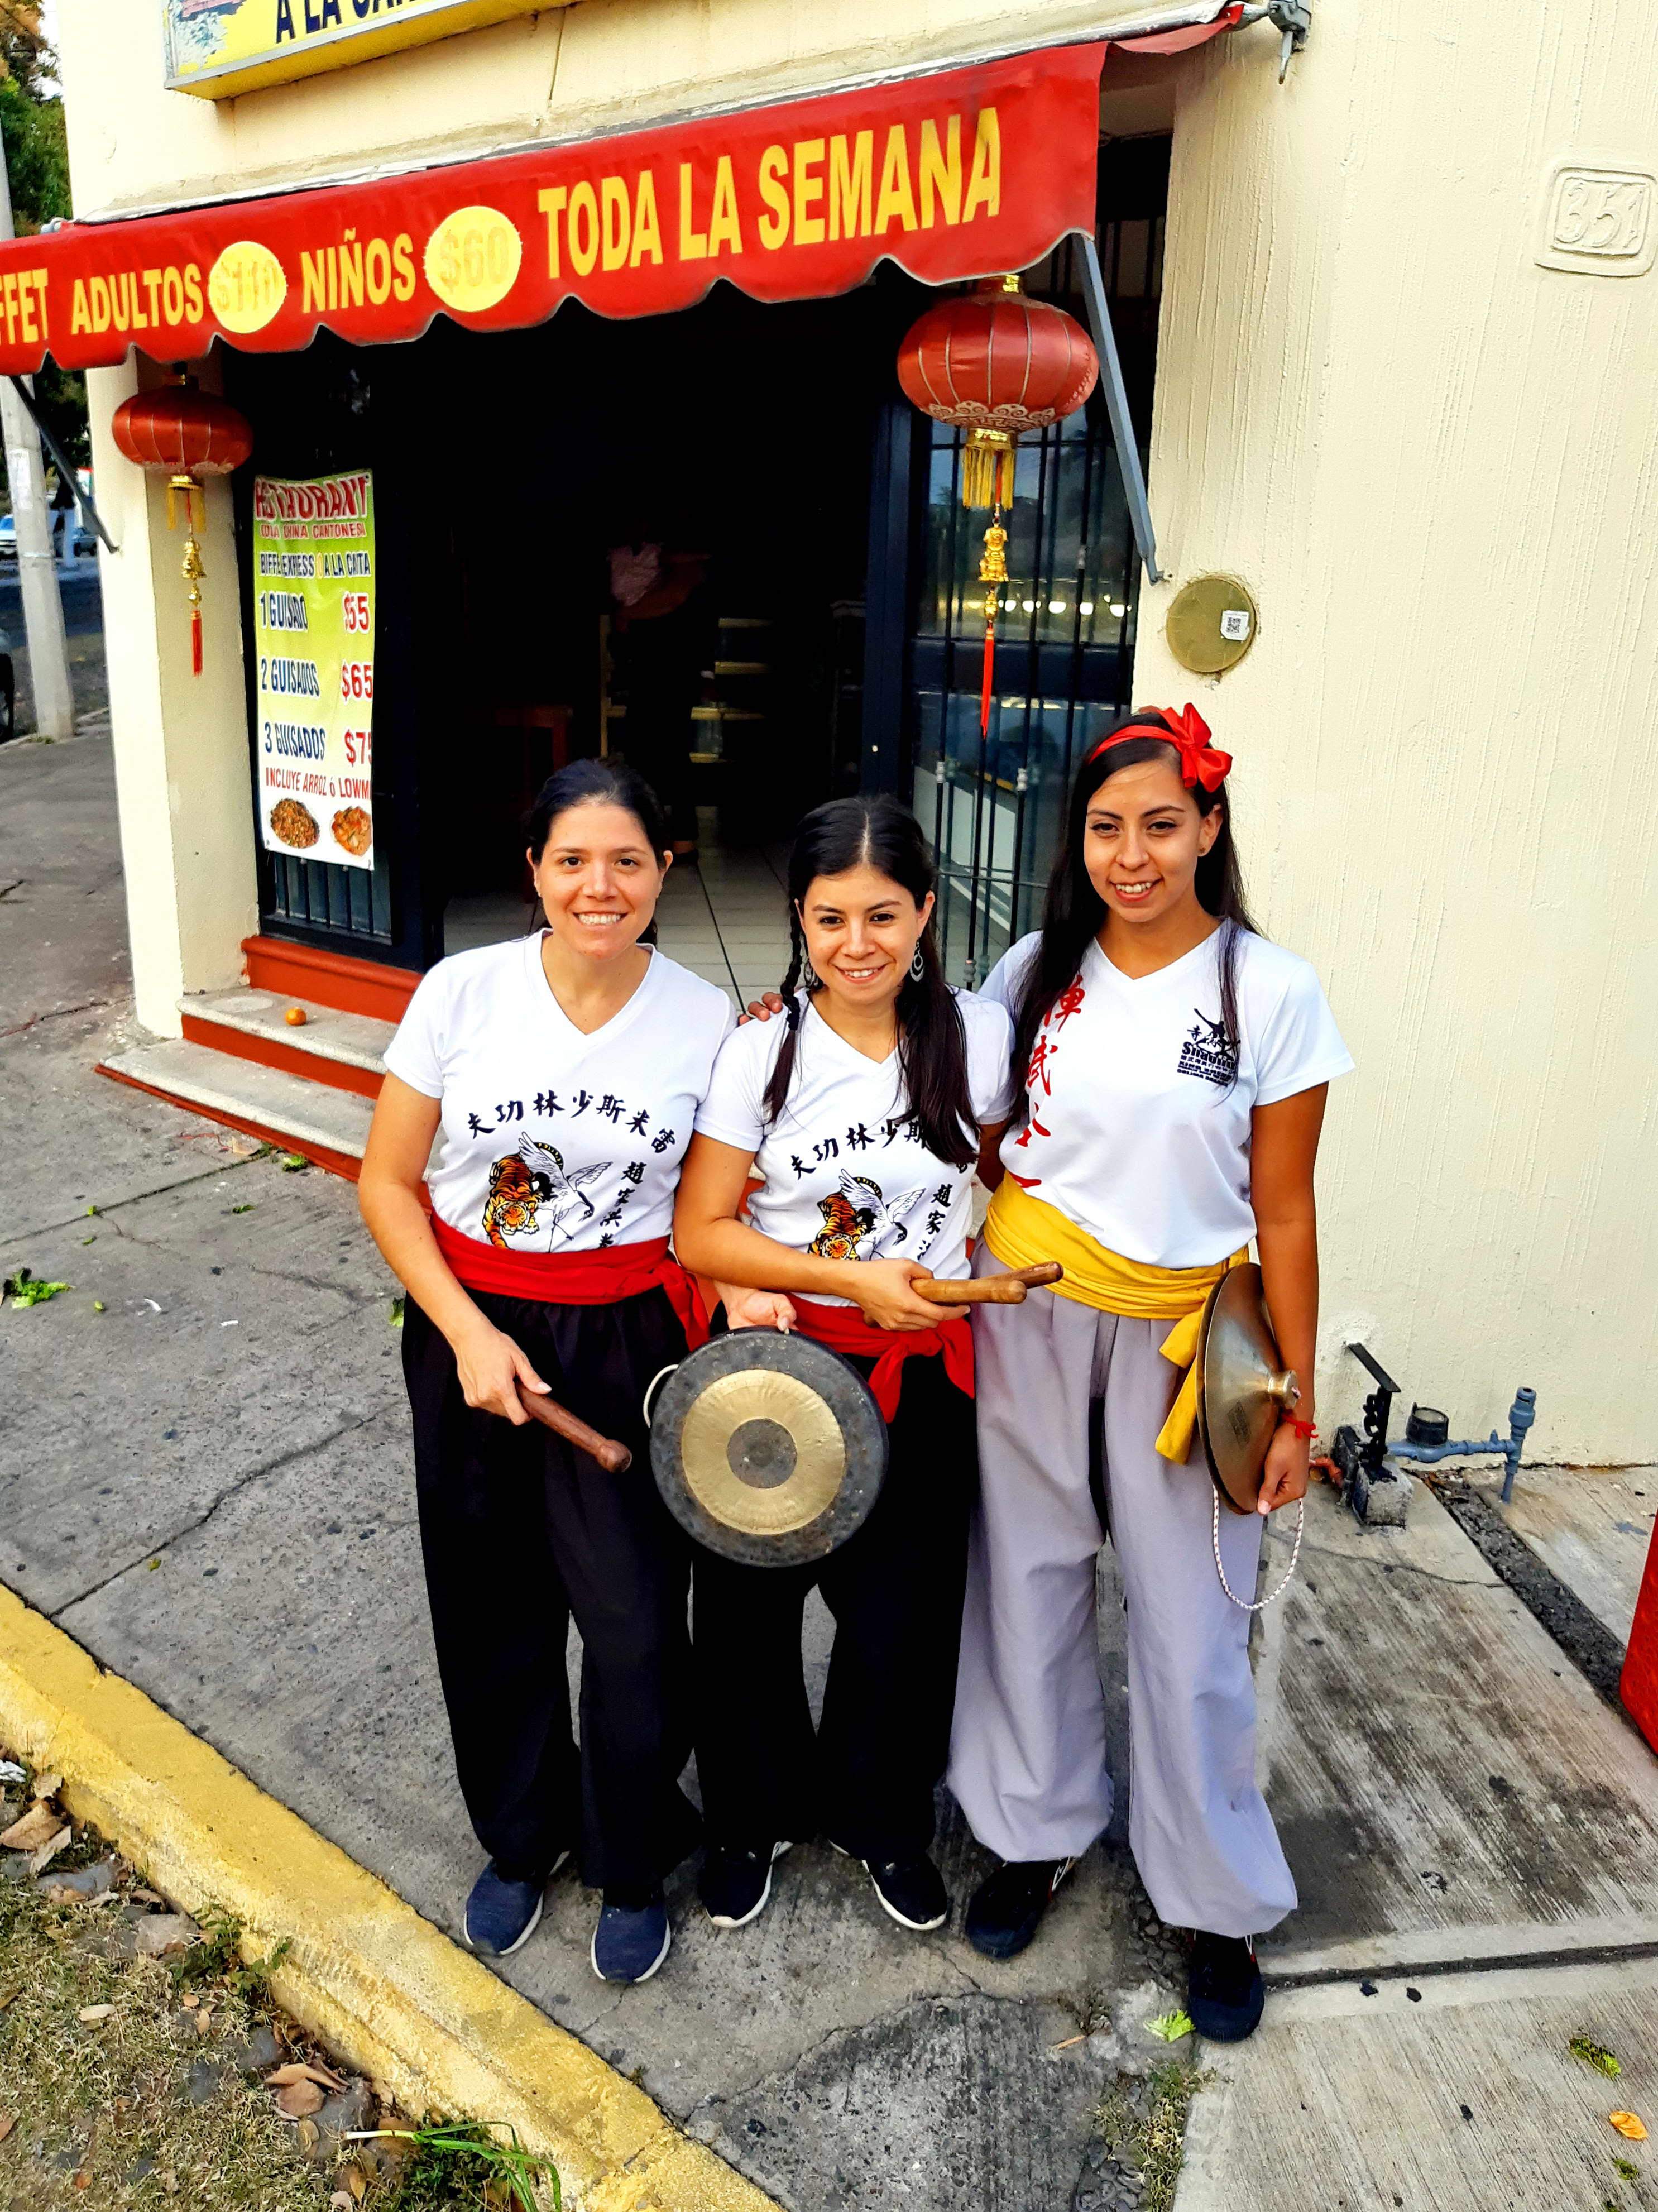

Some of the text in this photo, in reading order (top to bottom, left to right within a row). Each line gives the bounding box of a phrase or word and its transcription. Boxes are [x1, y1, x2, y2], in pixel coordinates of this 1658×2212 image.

[71, 263, 204, 335] ADULTOS
[301, 227, 416, 314] NIÑOS
[439, 227, 510, 294] $60
[538, 170, 663, 280] TODA
[679, 155, 743, 261] LA
[758, 107, 1002, 251] SEMANA
[260, 593, 267, 626] 1
[343, 593, 370, 631] $55
[261, 658, 373, 701] 2 GUISADOS $65
[265, 722, 272, 753] 3
[274, 722, 326, 761] GUISADOS
[266, 767, 301, 791] INCLUYE
[303, 773, 327, 796] ARROZ
[338, 777, 372, 801] LOWM
